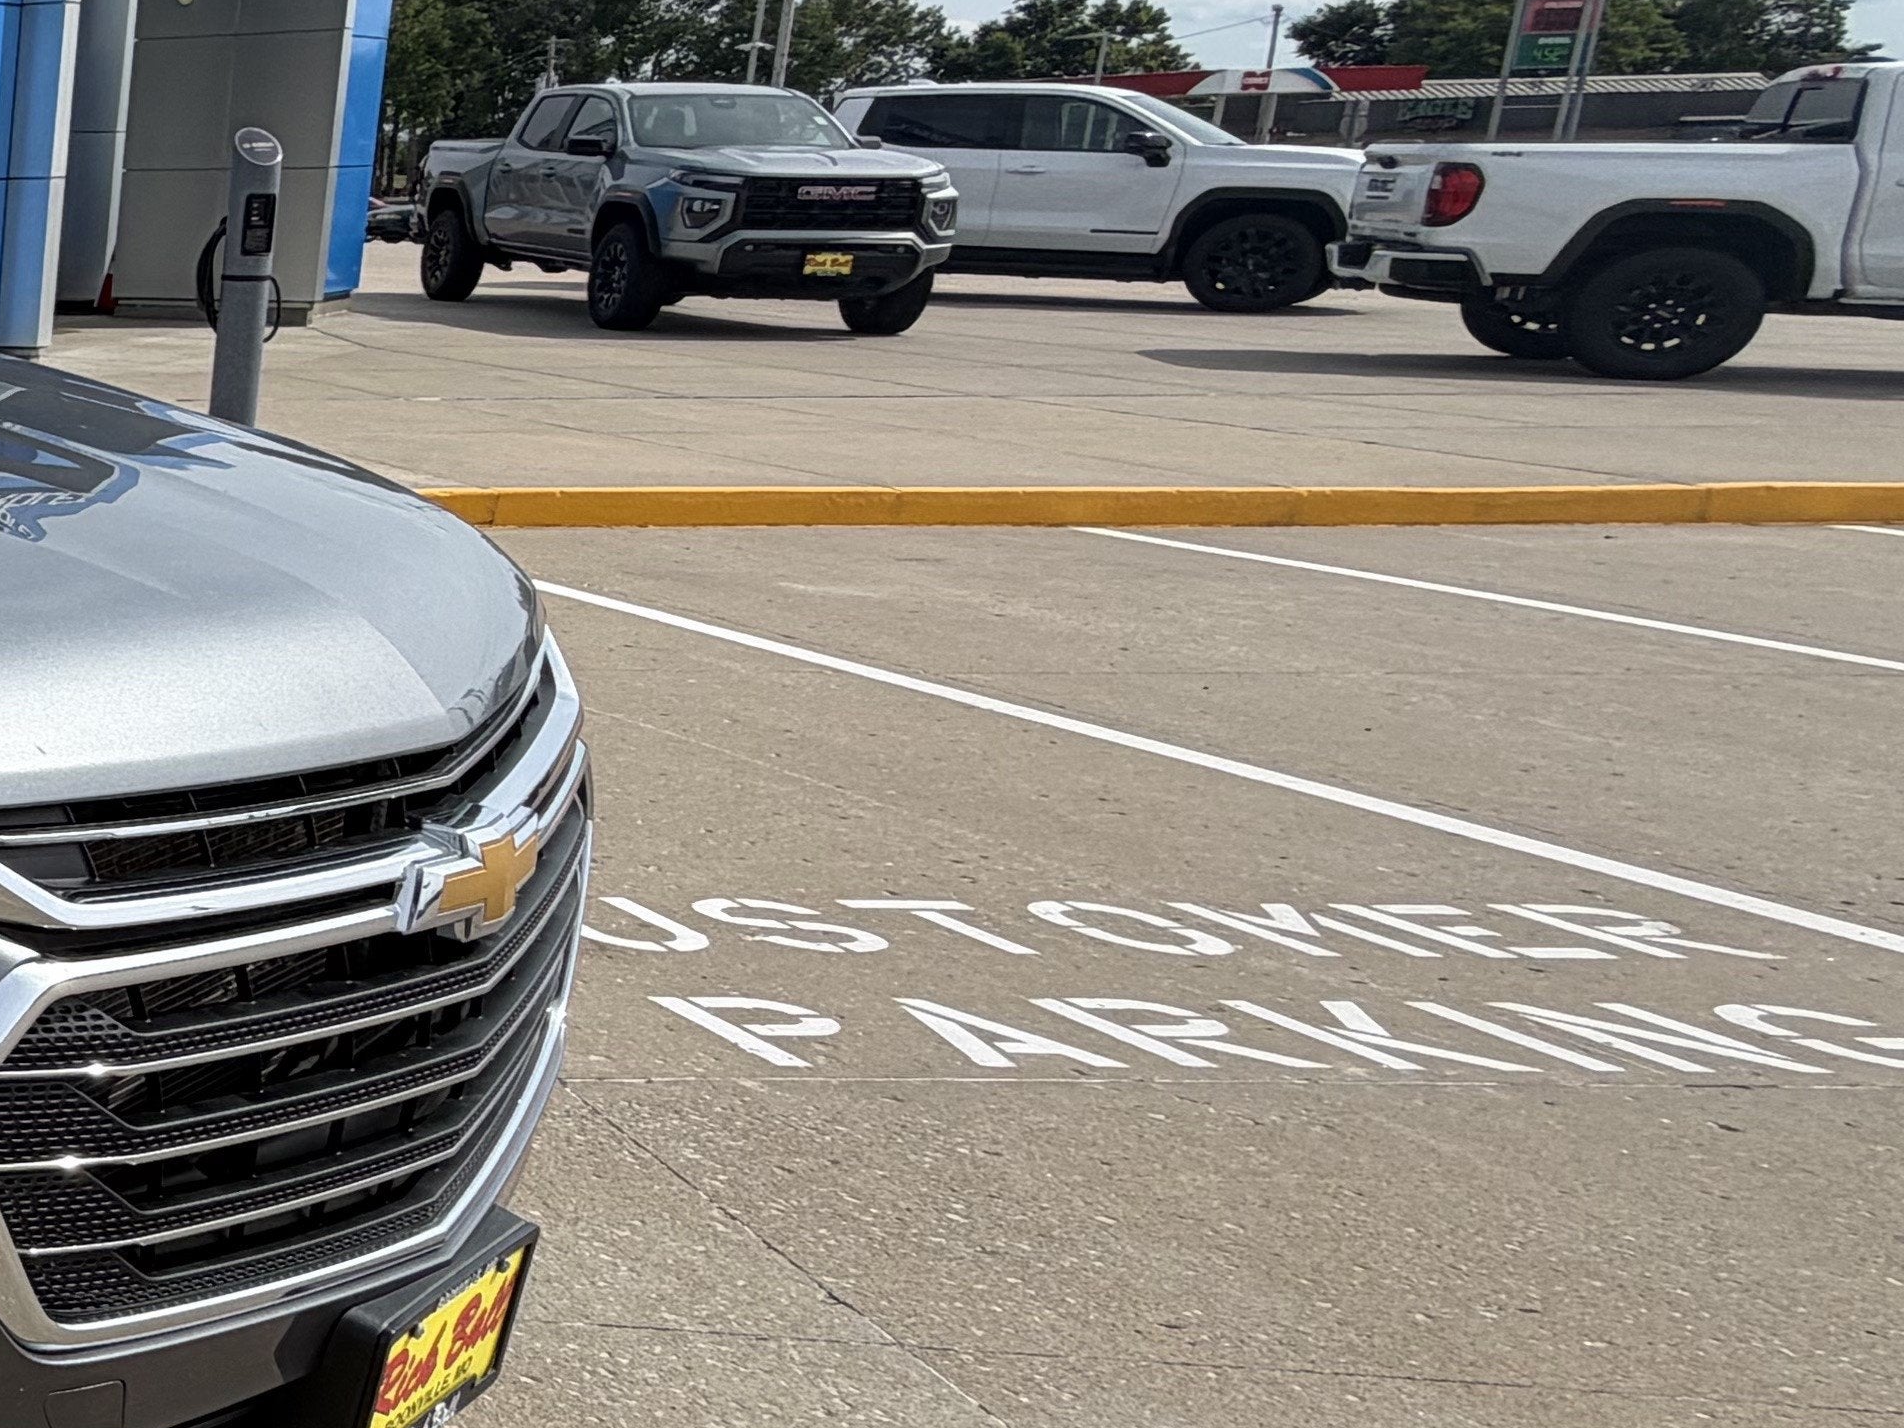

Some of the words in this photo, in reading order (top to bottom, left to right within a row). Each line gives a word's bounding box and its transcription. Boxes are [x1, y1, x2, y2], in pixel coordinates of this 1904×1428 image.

[797, 185, 878, 201] GMC
[580, 896, 1789, 960] USTOMER
[646, 995, 1904, 1074] PARKING
[375, 1319, 447, 1417] Rick
[443, 1273, 517, 1370] Ball
